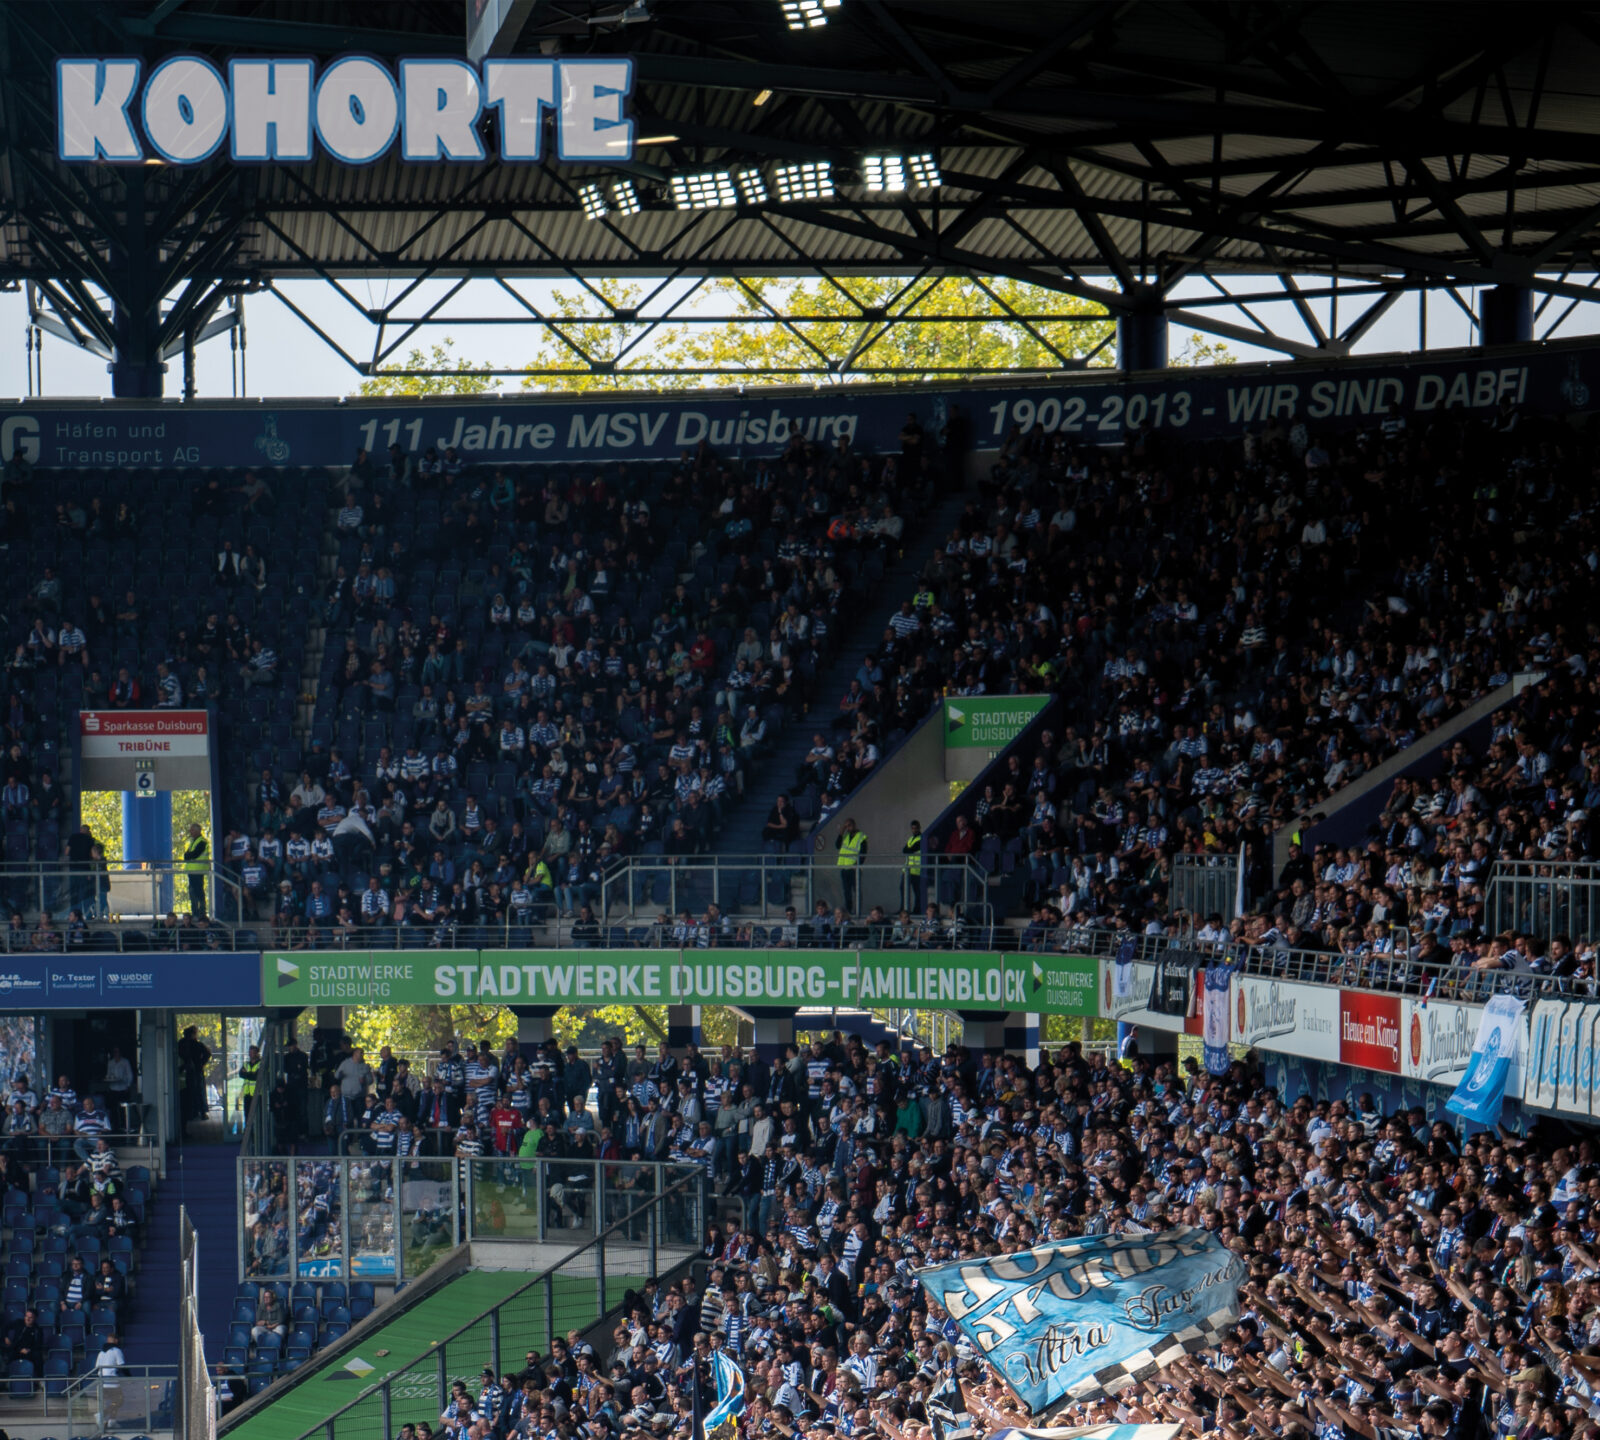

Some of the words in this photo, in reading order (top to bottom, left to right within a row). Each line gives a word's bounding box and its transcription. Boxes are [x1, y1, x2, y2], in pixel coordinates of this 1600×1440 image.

[989, 392, 1192, 436] 1902-2013
[1226, 384, 1299, 423] WIR
[1307, 377, 1404, 419] SIND
[129, 422, 165, 438] und
[359, 417, 422, 452] 111
[437, 417, 555, 451] Jahre
[567, 411, 668, 448] MSV
[675, 408, 858, 447] Duisburg
[57, 447, 163, 466] Transport
[173, 446, 200, 463] AG
[103, 721, 154, 733] Sparkasse
[157, 720, 203, 733] Duisburg
[118, 739, 171, 751] TRIBÜNE
[138, 773, 151, 789] 6
[309, 965, 414, 981] STADTWERKE
[1046, 970, 1094, 989] STADTWERKE
[309, 982, 391, 998] DUISBURG
[434, 965, 661, 997] STADTWERKE
[670, 964, 1027, 1003] DUISBURG-FAMILIENBLOCK
[1046, 989, 1084, 1008] DUISBURG
[1303, 1008, 1332, 1034] Fankurve
[1343, 1010, 1363, 1044] Heute
[1364, 1013, 1375, 1045] ein
[1376, 1015, 1398, 1064] König
[1004, 1321, 1114, 1386] Ultra
